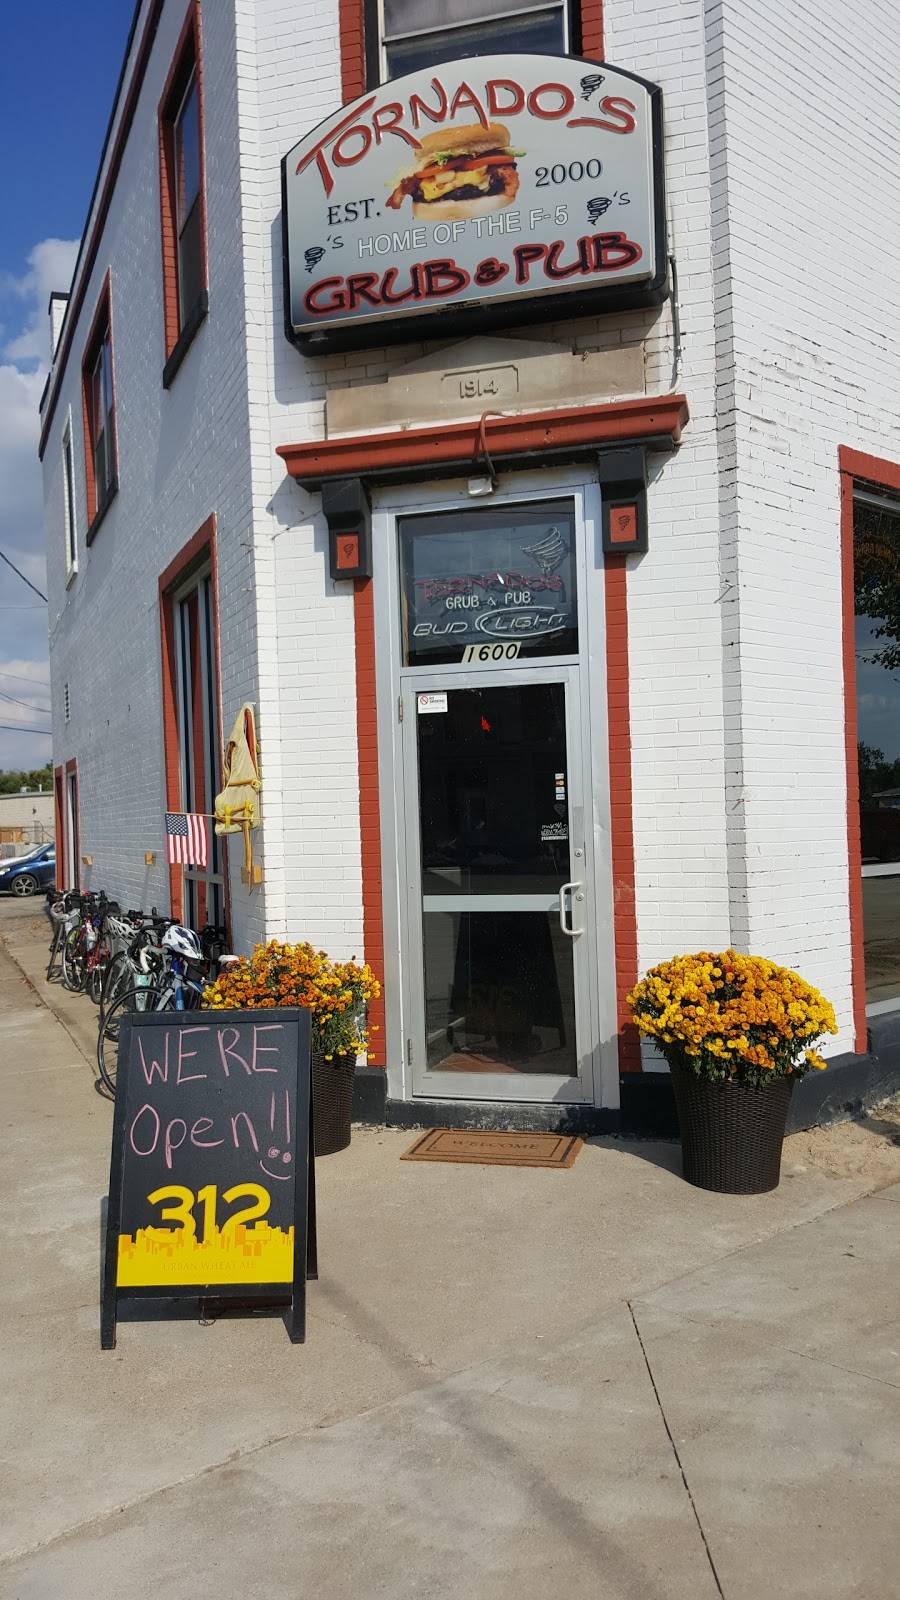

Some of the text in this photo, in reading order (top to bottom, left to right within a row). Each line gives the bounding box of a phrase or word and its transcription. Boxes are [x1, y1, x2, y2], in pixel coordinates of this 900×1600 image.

[326, 158, 602, 226] EST. 2000
[358, 205, 568, 258] HOME OF THE F-5
[303, 231, 642, 316] GRUB & PUB
[445, 595, 480, 609] GRUB
[504, 591, 531, 605] PUB
[413, 613, 569, 636] BUD LIGHT
[467, 643, 518, 663] 1600
[453, 1139, 539, 1150] WELCOME
[146, 1183, 271, 1244] 312
